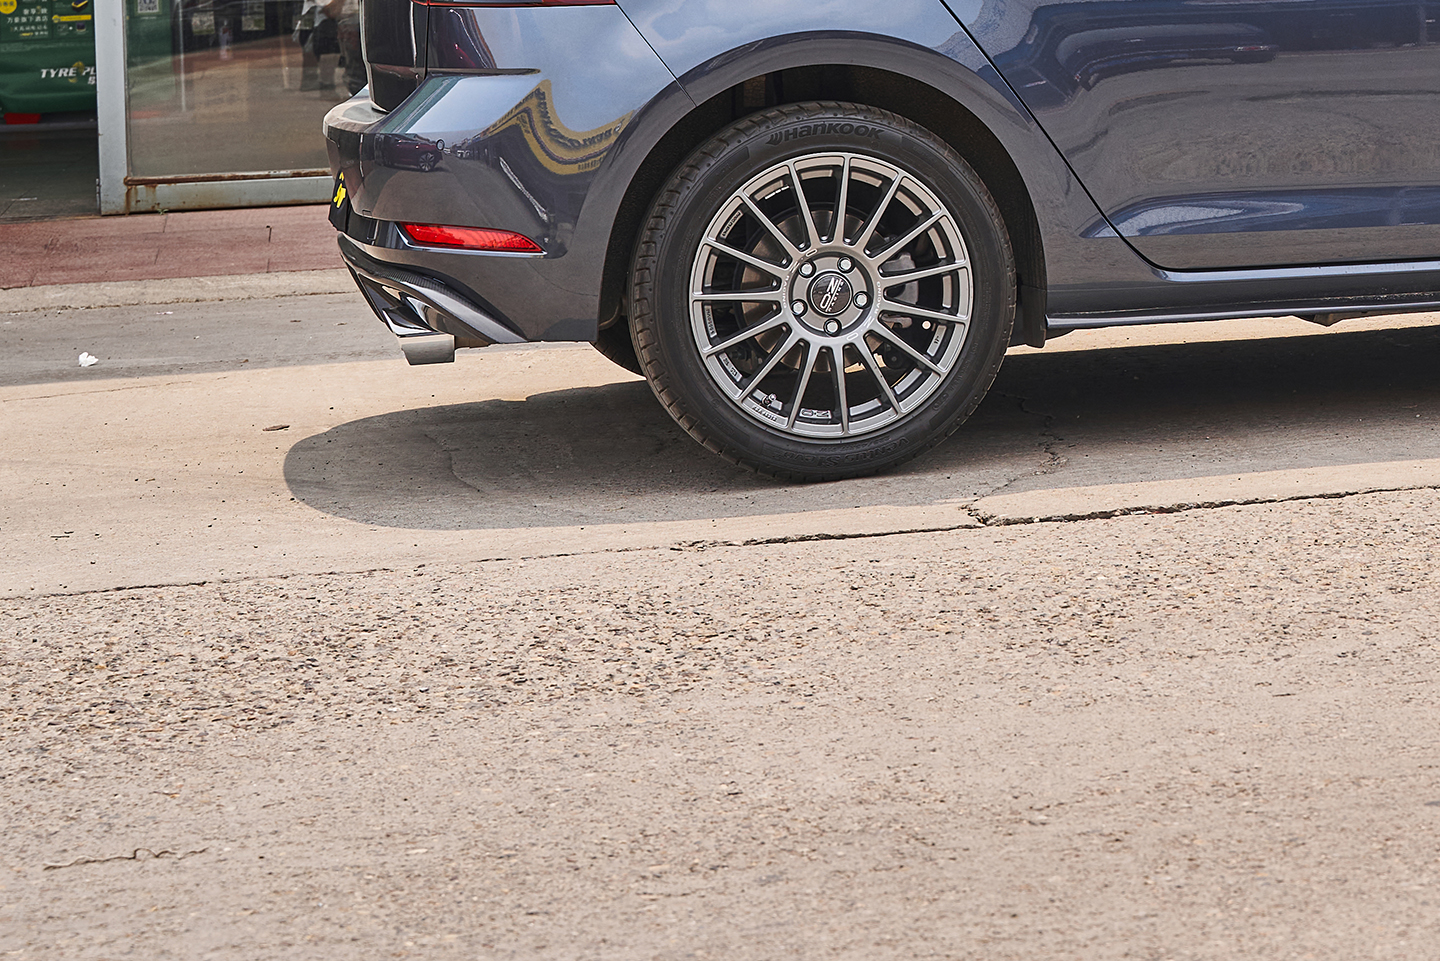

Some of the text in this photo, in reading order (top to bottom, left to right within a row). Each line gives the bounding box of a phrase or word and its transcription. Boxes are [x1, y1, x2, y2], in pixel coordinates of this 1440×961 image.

[41, 68, 77, 79] TYRE
[782, 275, 790, 308] RACING
[874, 280, 882, 314] RACING
